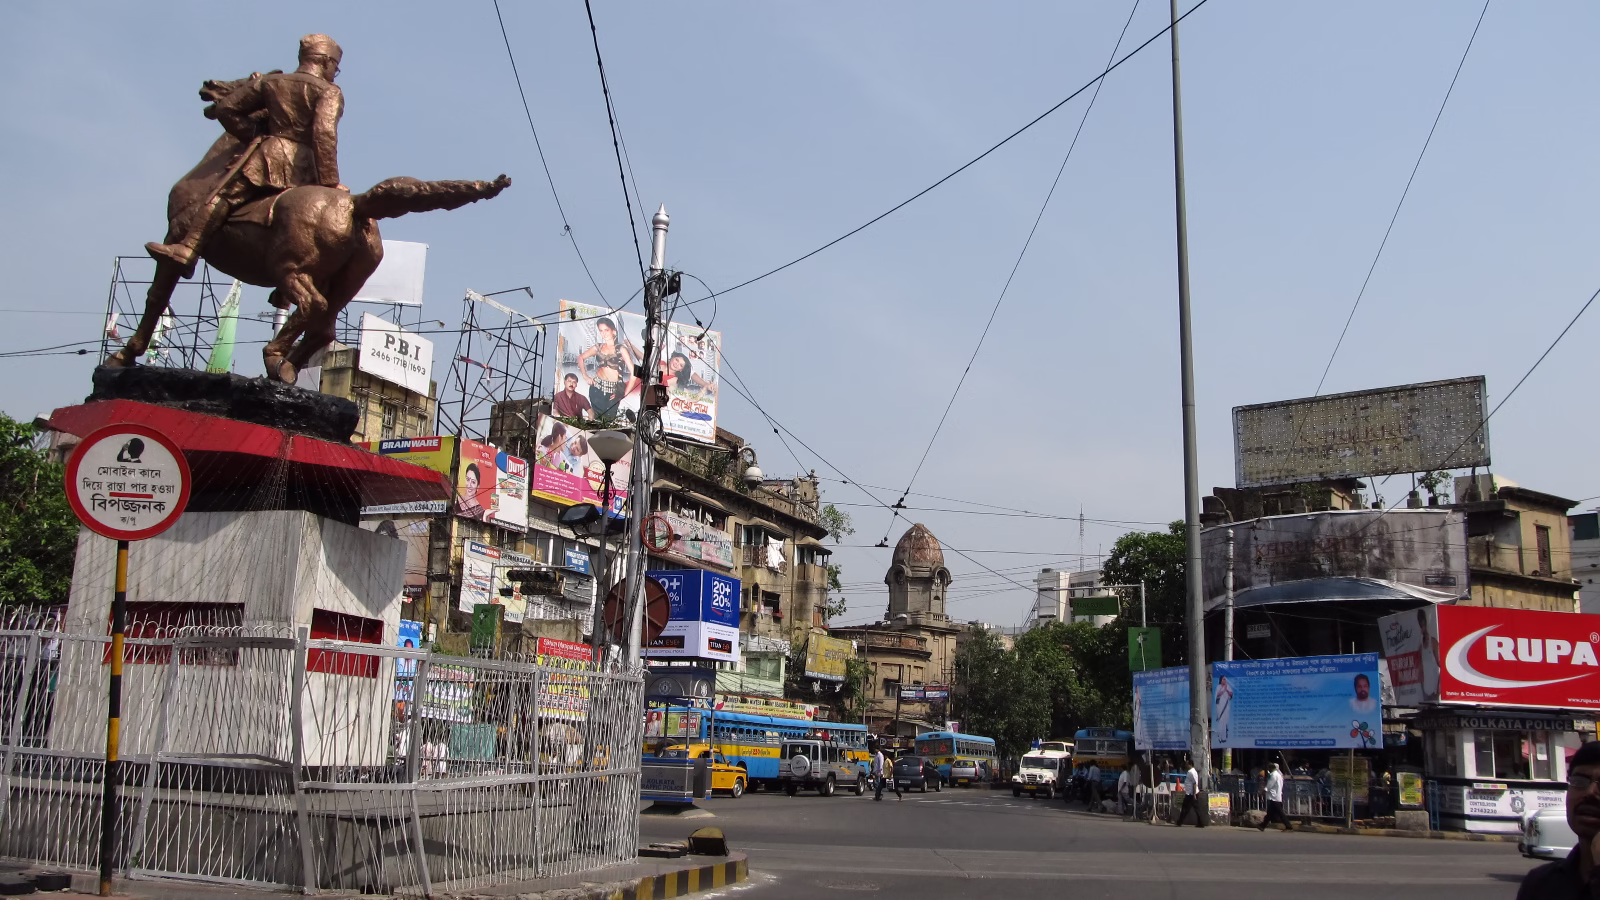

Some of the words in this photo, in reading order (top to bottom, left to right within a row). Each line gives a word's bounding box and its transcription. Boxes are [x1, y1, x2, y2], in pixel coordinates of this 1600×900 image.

[383, 332, 421, 361] P.B.I
[382, 439, 439, 450] BRAINWARE
[97, 466, 136, 479] মোবাইল
[139, 469, 161, 479] কানে
[82, 478, 102, 491] দিয়ে
[107, 482, 126, 492] রাস্তা
[130, 484, 147, 493] পার
[150, 485, 175, 494] হওয়া
[90, 493, 166, 514] বিপজ্জনক
[713, 581, 731, 596] 20+
[713, 595, 731, 608] 20%
[1486, 635, 1599, 667] RUPA
[1460, 717, 1522, 730] KOLKATA
[1525, 718, 1573, 731] POLICE
